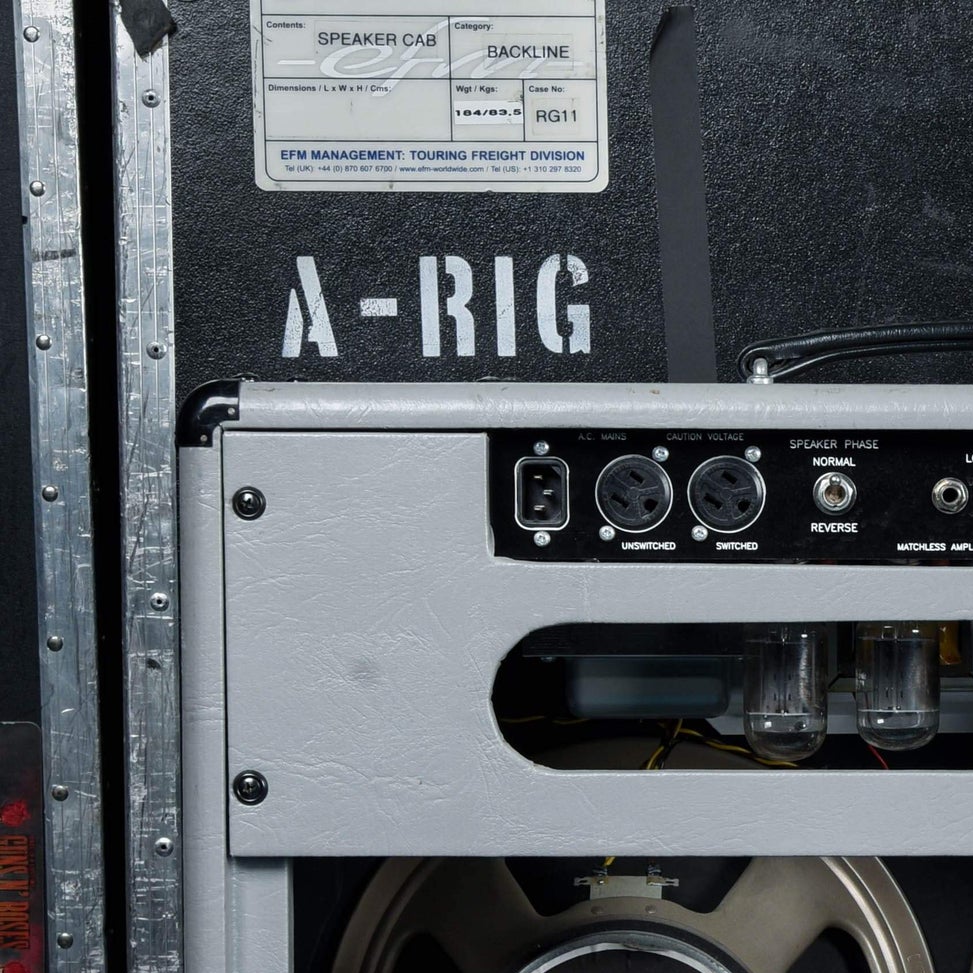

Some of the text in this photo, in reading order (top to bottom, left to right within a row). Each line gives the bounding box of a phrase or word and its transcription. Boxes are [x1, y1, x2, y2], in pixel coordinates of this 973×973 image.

[266, 21, 306, 29] Contents:
[454, 22, 494, 31] Category:
[317, 32, 437, 47] SPEAKER CAB
[487, 45, 570, 59] BACKLINE
[268, 84, 317, 92] Dimensions
[323, 84, 329, 92] L
[338, 84, 347, 92] W
[356, 84, 363, 92] H
[456, 85, 473, 94] Wgt
[479, 85, 498, 94] Kgs:
[528, 85, 565, 93] Case No:
[536, 109, 577, 123] RG11
[280, 150, 585, 161] EFM MANAGEMENT: TOURING FREIGHT DIVISION
[333, 165, 343, 173] (0)
[578, 433, 627, 441] A.C. MAINS
[666, 433, 745, 441] CAUTION VOLTAGE
[789, 439, 880, 450] SPEAKER PHASE
[812, 456, 857, 468] NORMAL
[810, 522, 859, 534] REVERSE
[621, 542, 677, 552] UNSWITCHED
[715, 542, 759, 552] SWITCHED
[897, 542, 947, 552] MATCHLESS
